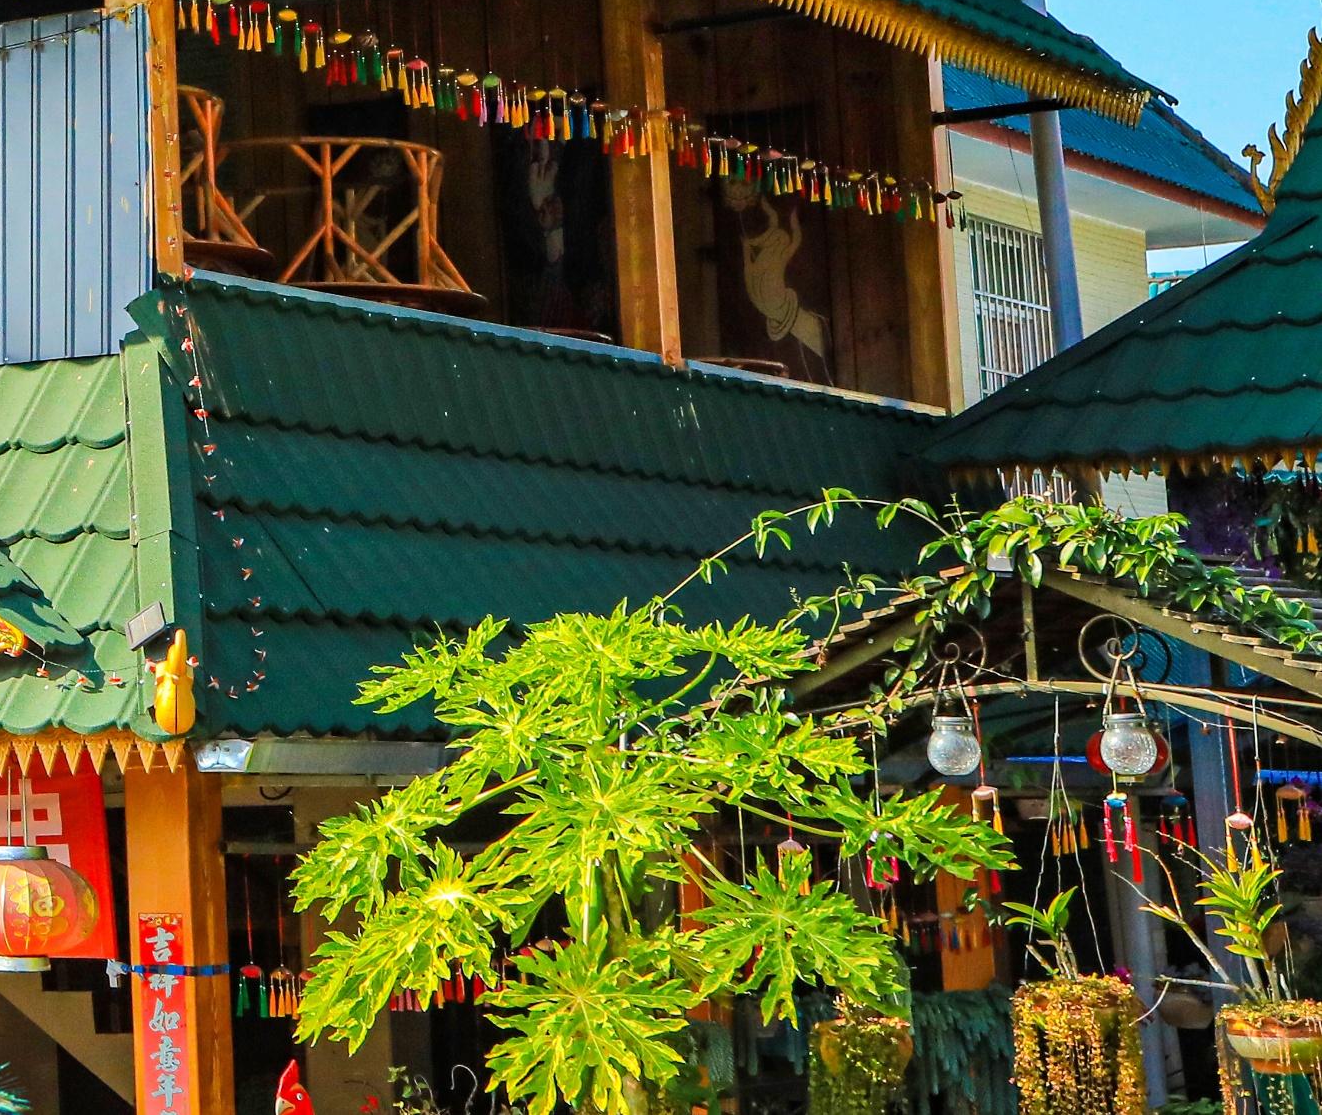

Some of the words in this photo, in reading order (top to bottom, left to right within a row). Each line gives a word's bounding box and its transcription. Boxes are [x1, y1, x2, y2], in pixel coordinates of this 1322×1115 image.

[145, 927, 184, 1115] 吉祥如意年
